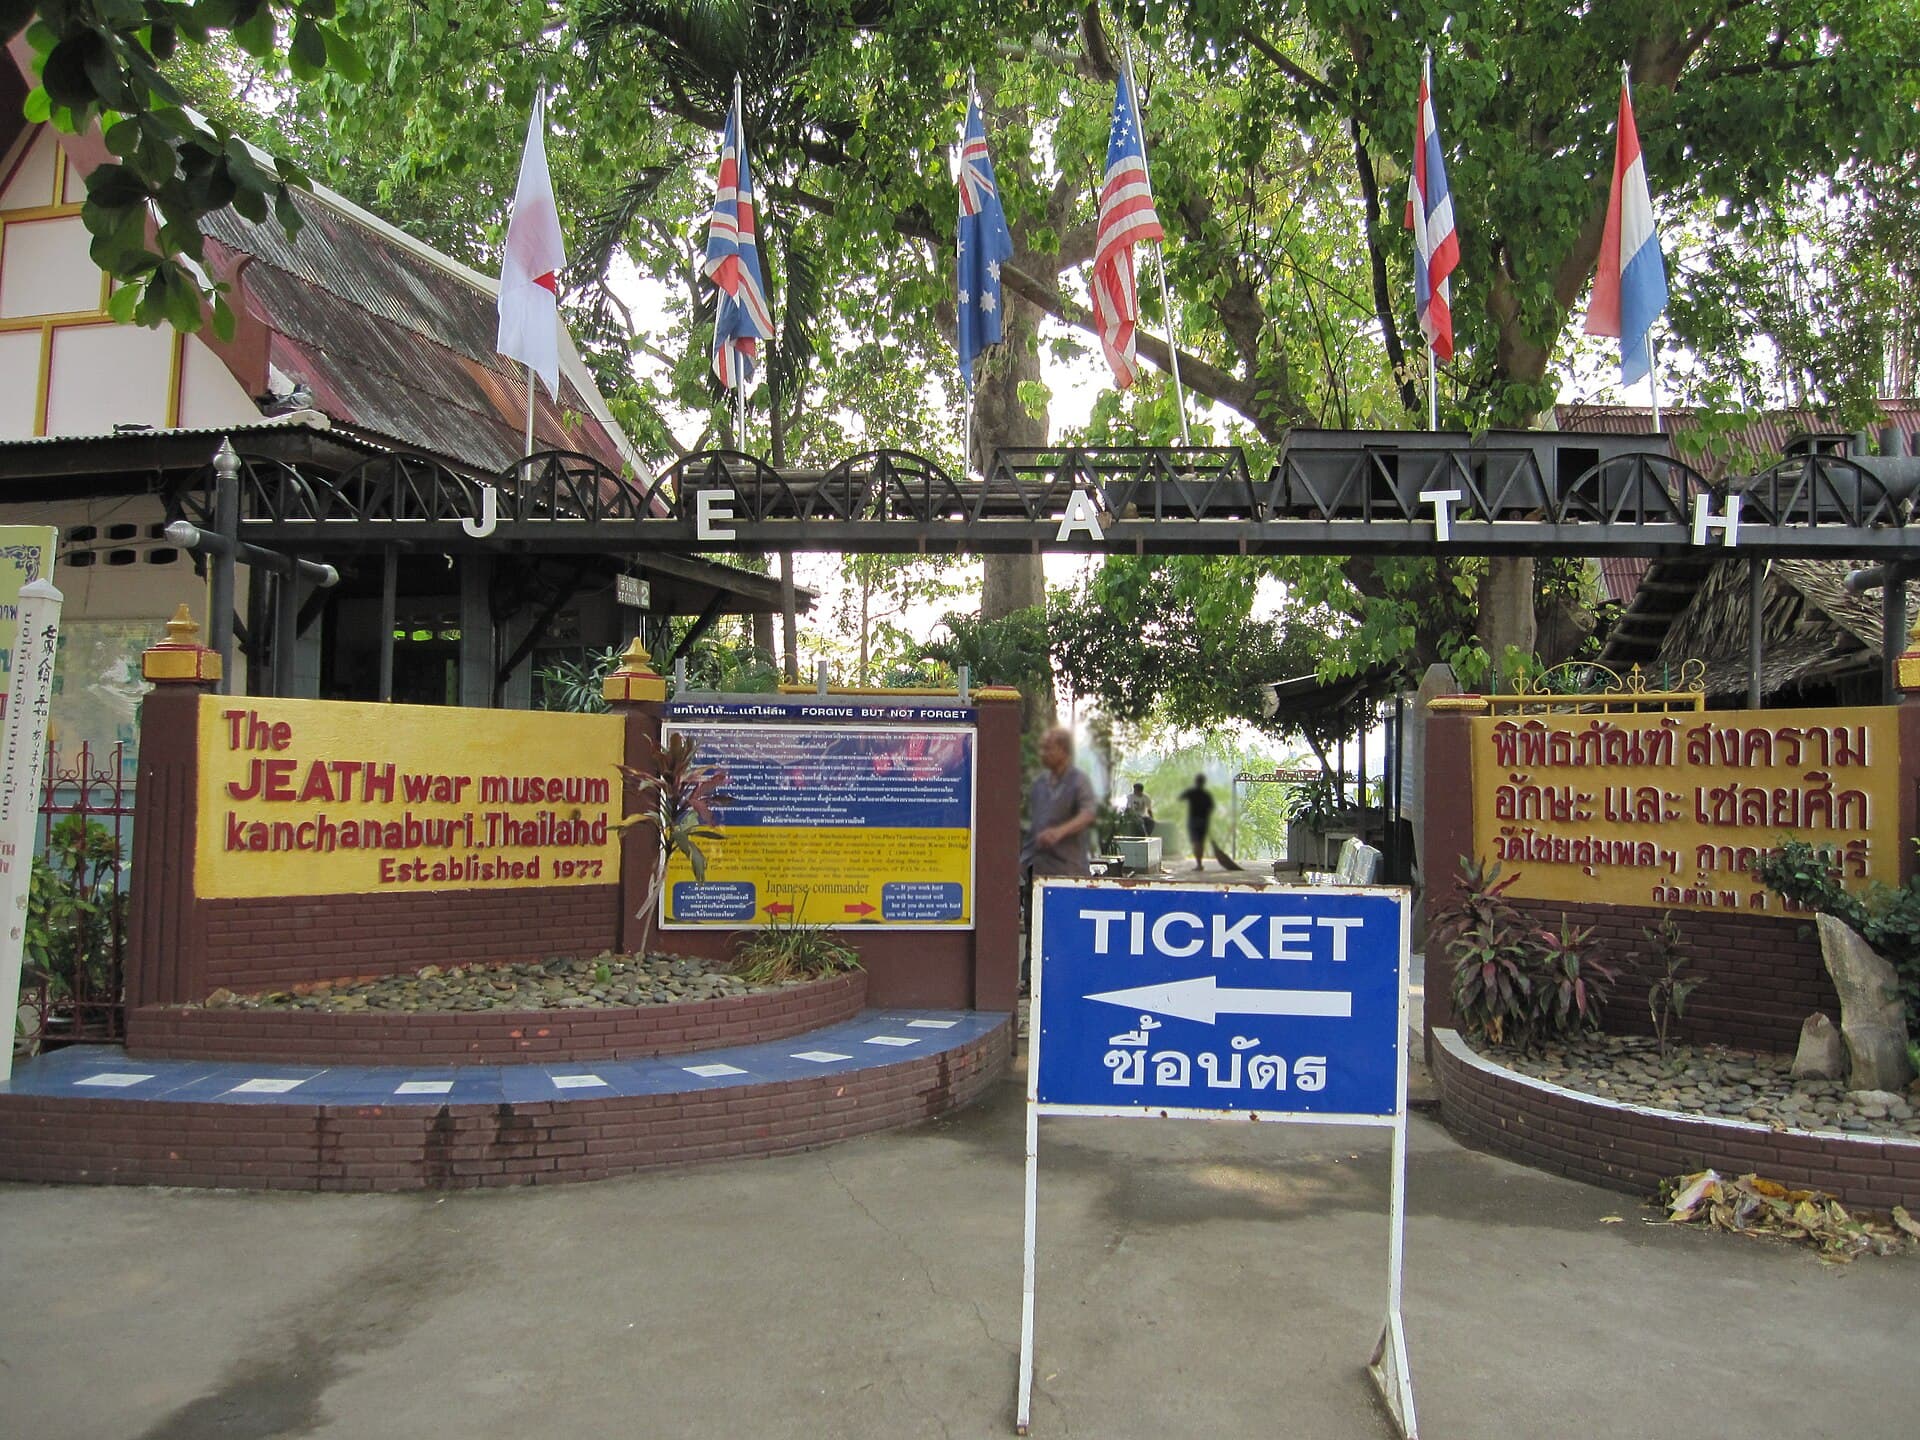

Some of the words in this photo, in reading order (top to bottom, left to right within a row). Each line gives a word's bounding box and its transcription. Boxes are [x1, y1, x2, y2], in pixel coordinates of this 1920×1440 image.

[461, 486, 497, 538] J
[696, 489, 737, 541] E
[1055, 490, 1105, 542] A
[1420, 490, 1462, 541] T
[1692, 493, 1741, 547] H
[223, 710, 292, 751] The
[801, 707, 853, 717] FORGIVE
[861, 709, 885, 717] BUT
[890, 709, 914, 718] NOT
[920, 710, 967, 719] FORGET
[1686, 722, 1871, 768] สงคราม
[227, 758, 396, 802] JEATH
[403, 773, 472, 804] war
[481, 775, 610, 804] museum
[1495, 773, 1592, 823] อักษะ
[1604, 785, 1682, 825] และ
[380, 856, 541, 885] Established
[552, 859, 604, 879] 1977
[766, 880, 809, 896] Japanese
[812, 881, 869, 894] commander
[1079, 909, 1364, 962] TICKET
[1103, 1014, 1327, 1092] ซื้อบัตร
